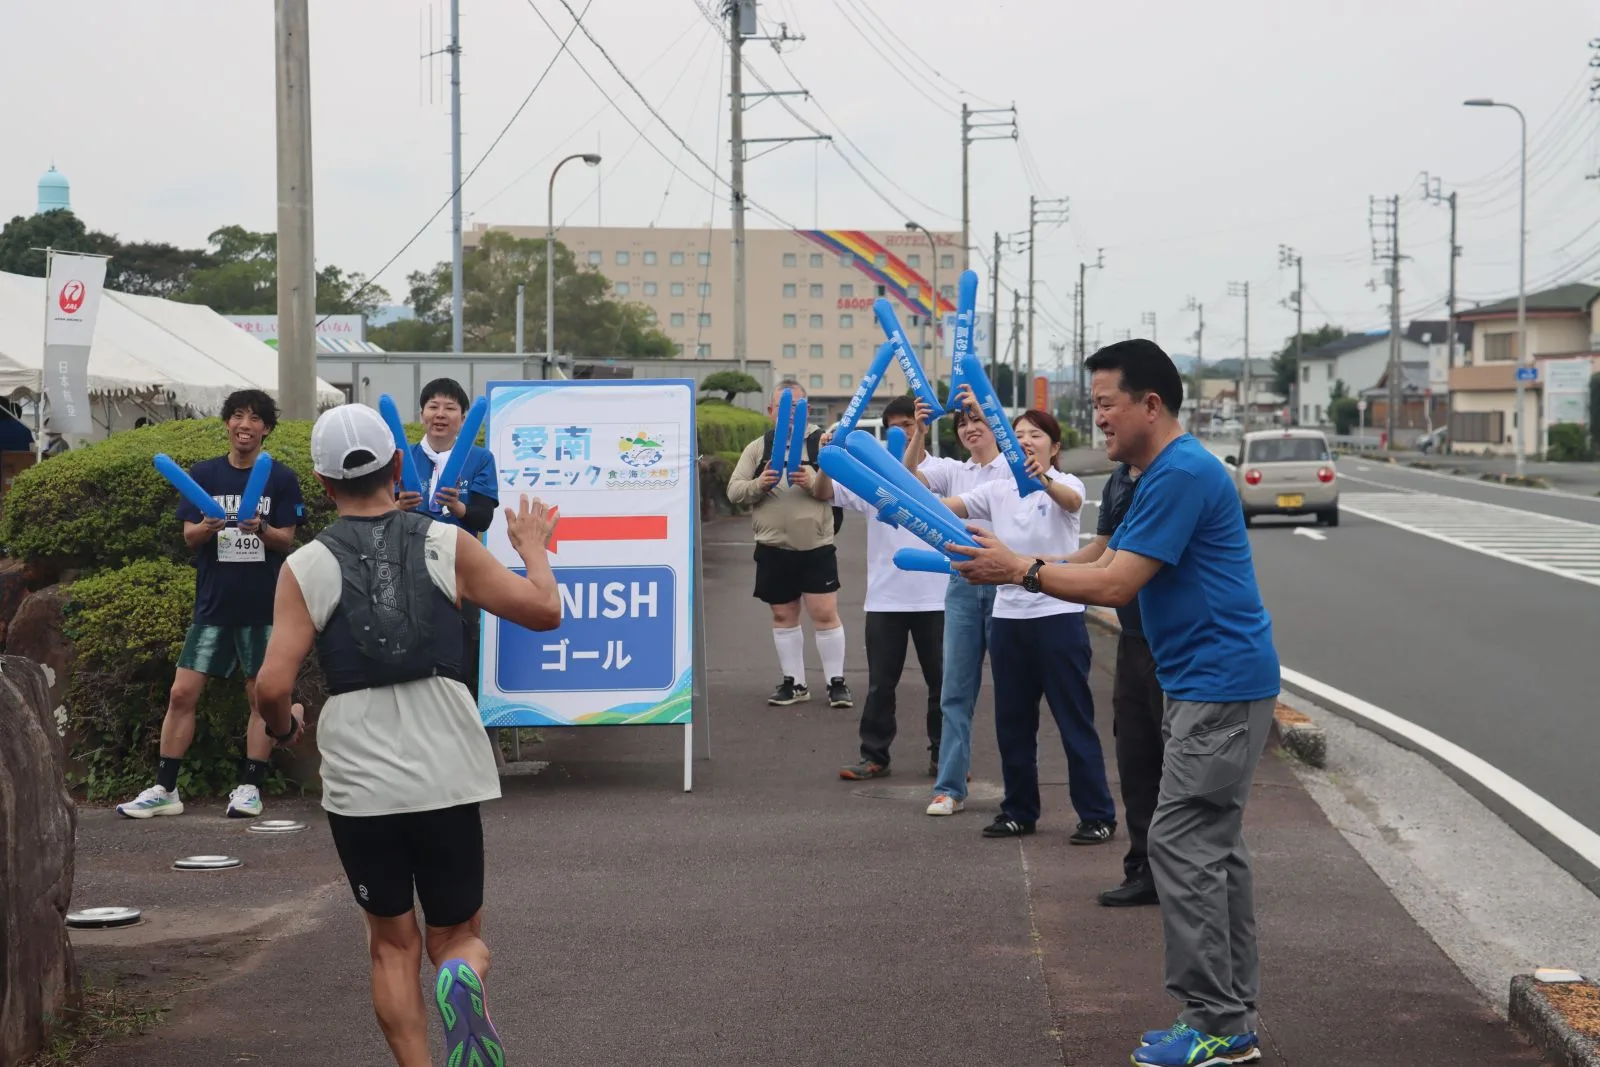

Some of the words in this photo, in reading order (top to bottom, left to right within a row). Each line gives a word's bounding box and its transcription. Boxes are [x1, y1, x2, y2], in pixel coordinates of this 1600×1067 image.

[511, 425, 593, 462] 愛南
[499, 465, 601, 487] マラニック
[234, 537, 260, 550] 490
[372, 525, 397, 611] salomon
[557, 581, 658, 619] NISH
[541, 638, 632, 672] ゴール
